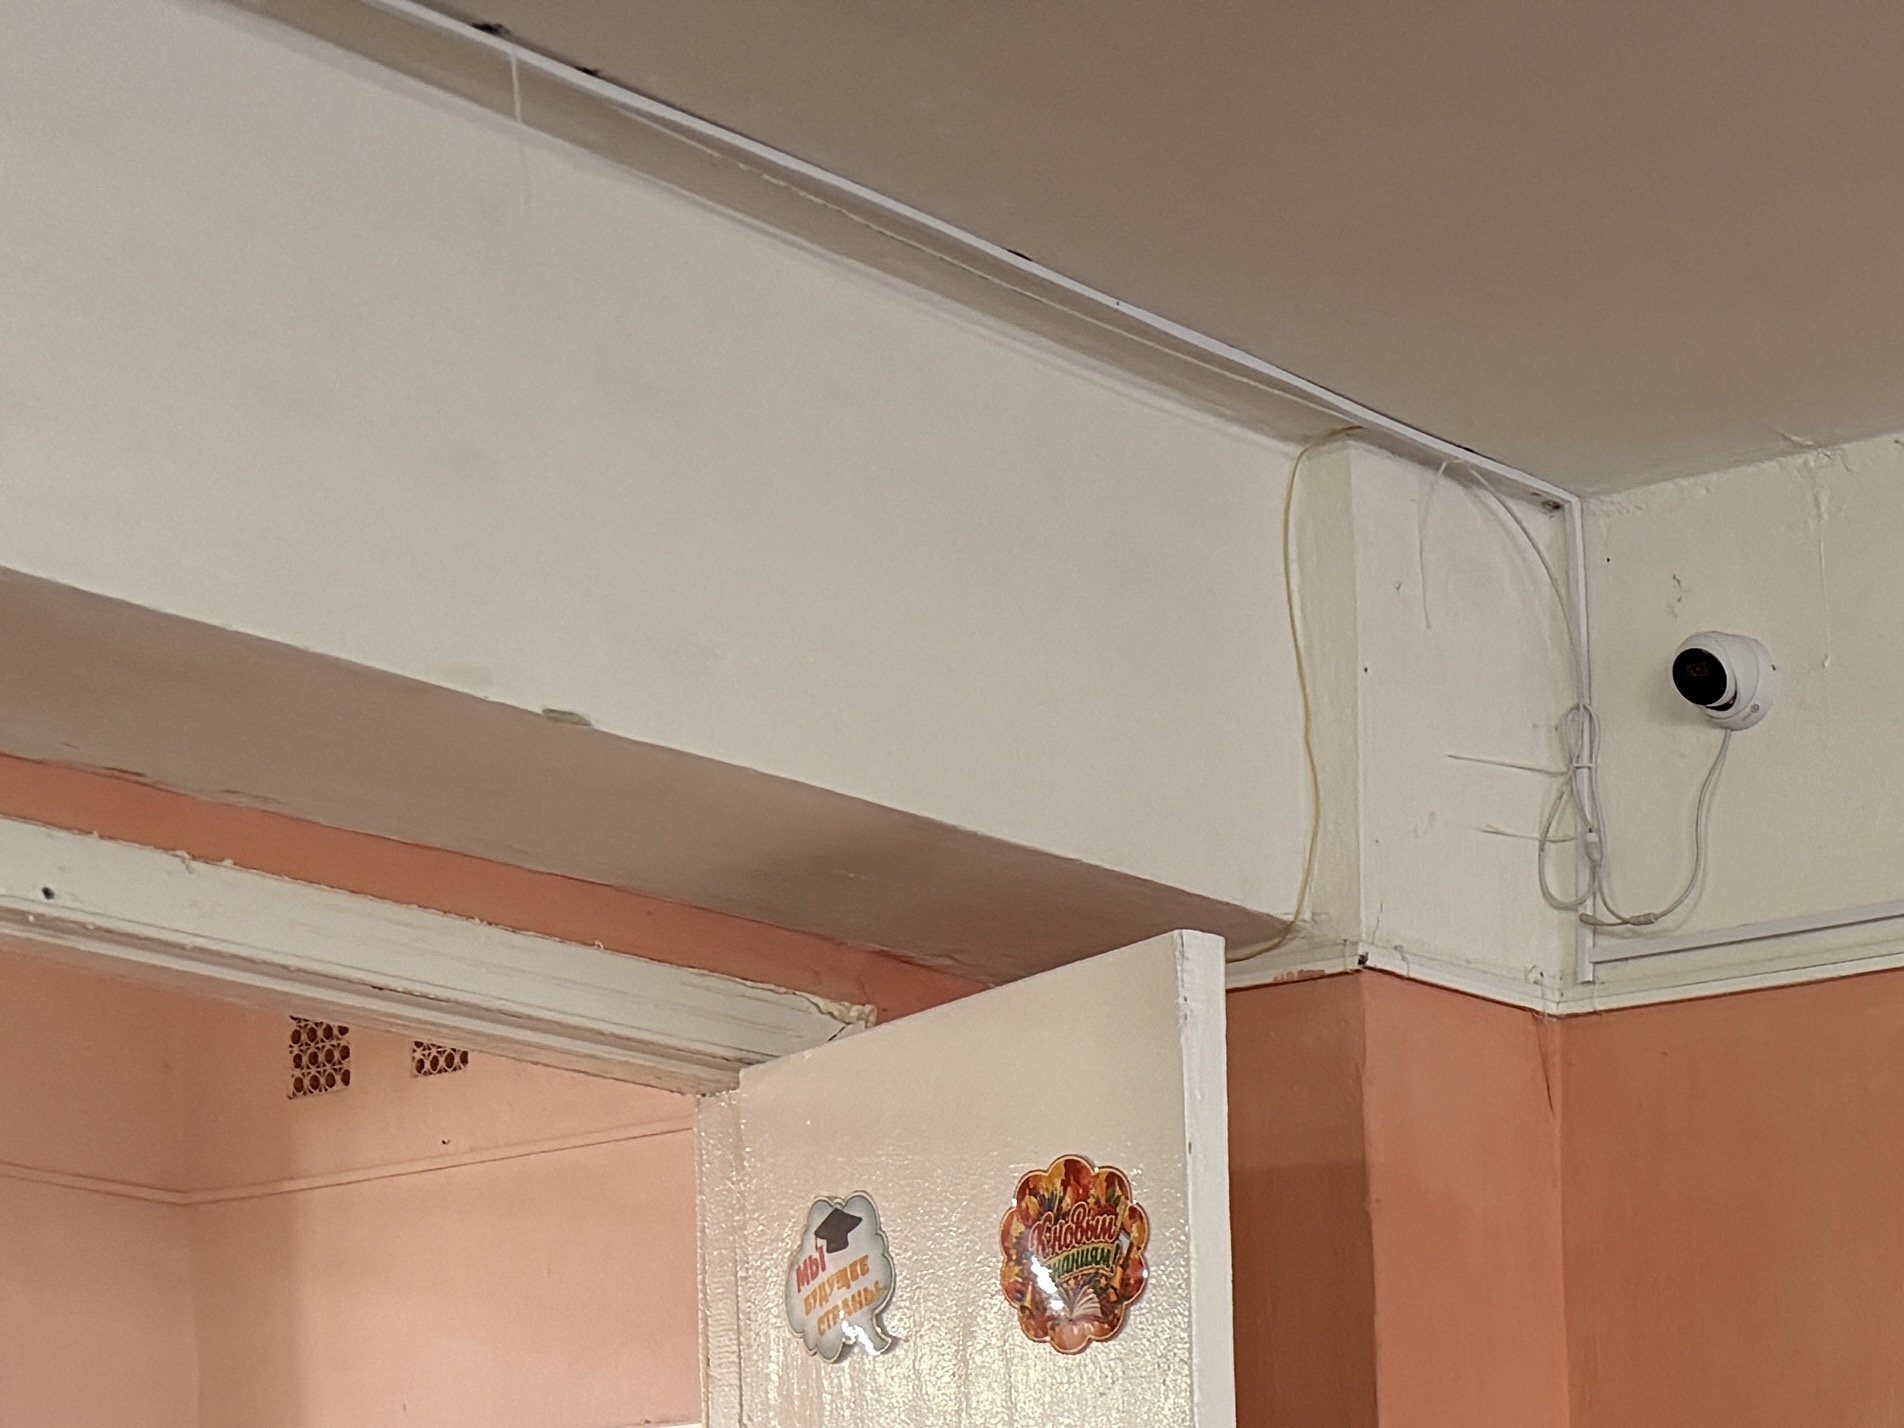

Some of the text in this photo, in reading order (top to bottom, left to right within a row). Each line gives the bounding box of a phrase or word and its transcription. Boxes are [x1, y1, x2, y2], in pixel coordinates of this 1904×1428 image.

[796, 1245, 826, 1293] МЫ
[804, 1255, 870, 1316] БУДУЩЕЕ
[817, 1280, 883, 1336] СТРАНЫ
